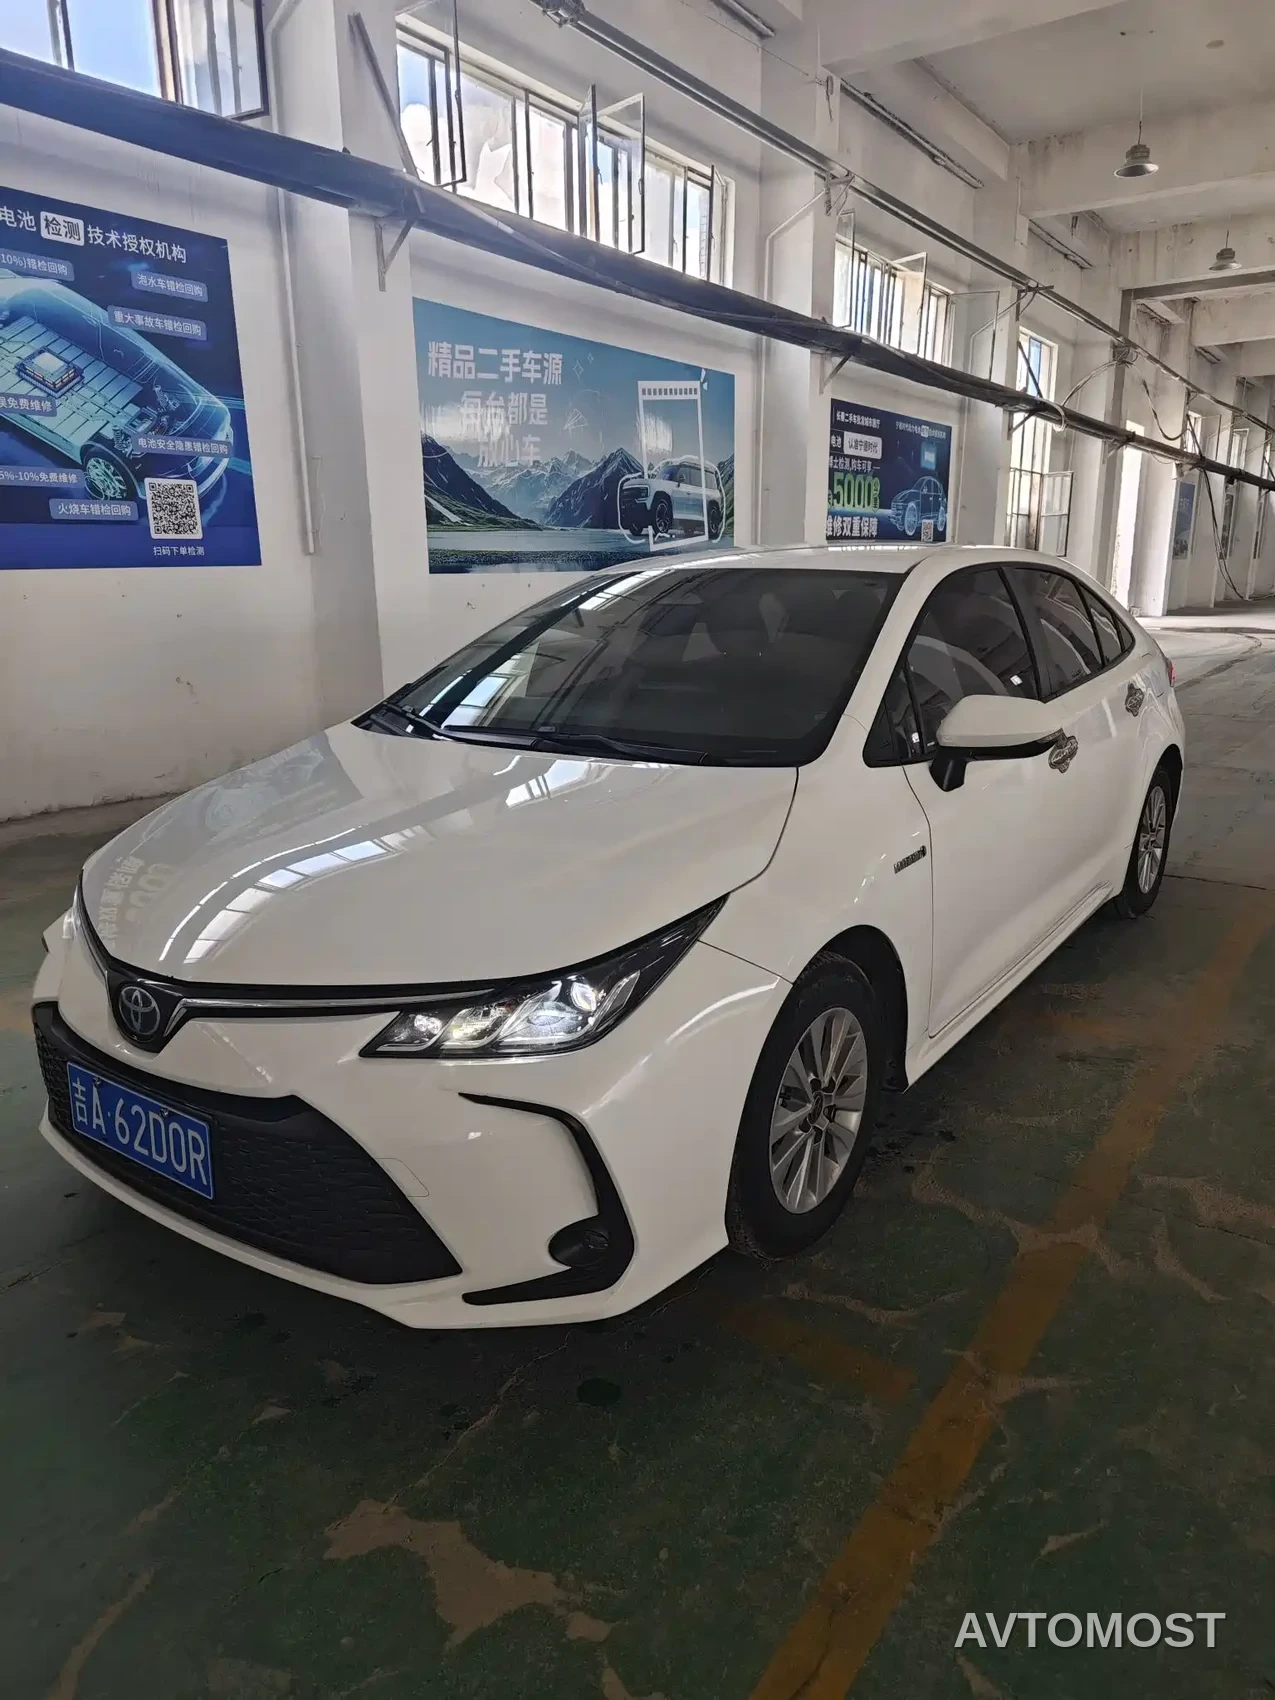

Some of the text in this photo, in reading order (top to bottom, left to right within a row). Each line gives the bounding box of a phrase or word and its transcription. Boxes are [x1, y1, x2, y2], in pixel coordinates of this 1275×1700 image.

[0, 206, 187, 264] 电池 检测 技术授权机构
[137, 273, 203, 297] 泡水车错检回购
[113, 310, 202, 336] 重大事故车错检回购
[428, 341, 563, 385] 精品二手车源
[138, 437, 229, 455] 电池安全隐患错检回购
[831, 434, 878, 454] 电池 认准宁德时代
[833, 471, 873, 509] 5000
[58, 503, 131, 516] 火烧车错检回购
[153, 546, 205, 556] 扫码下单检测
